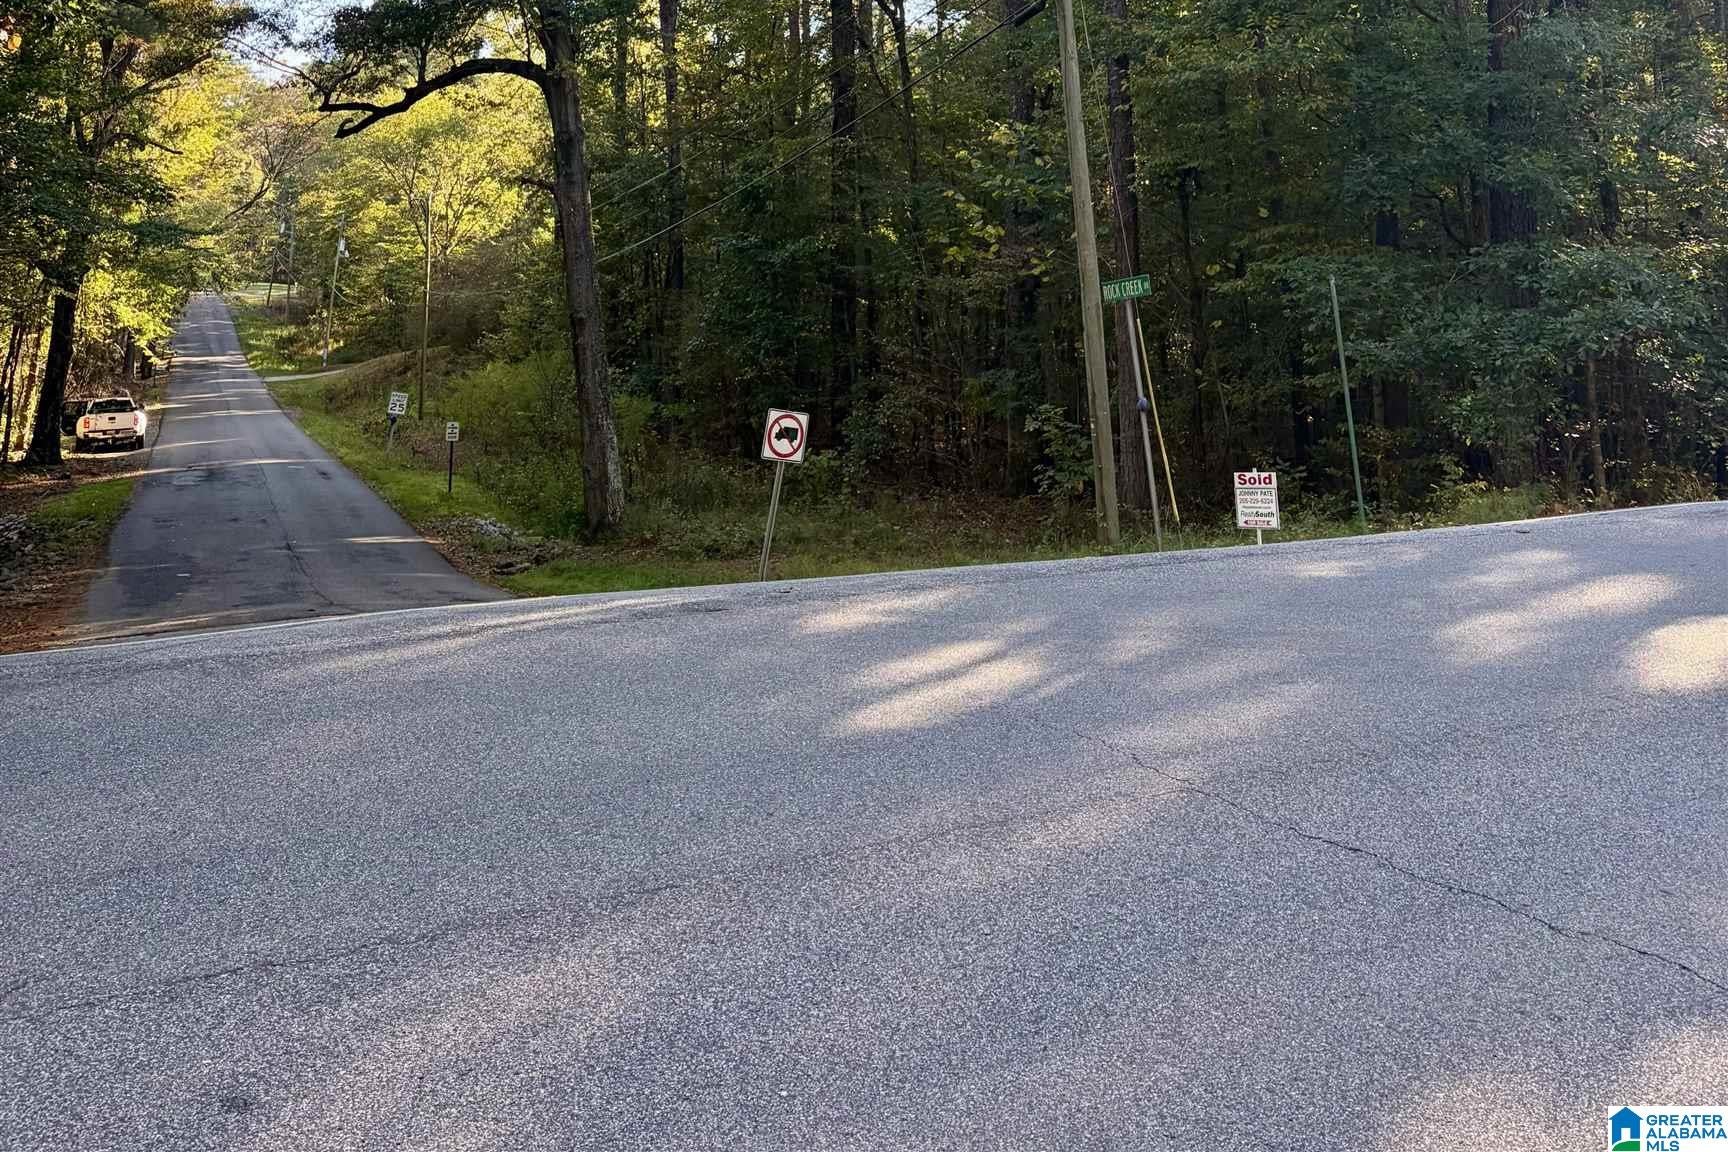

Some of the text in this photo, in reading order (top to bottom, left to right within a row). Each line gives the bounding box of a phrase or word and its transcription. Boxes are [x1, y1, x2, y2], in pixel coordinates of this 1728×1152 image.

[1103, 283, 1120, 301] ROCK
[1121, 279, 1143, 297] CREEK
[390, 402, 405, 412] 25
[1238, 473, 1272, 485] Sold
